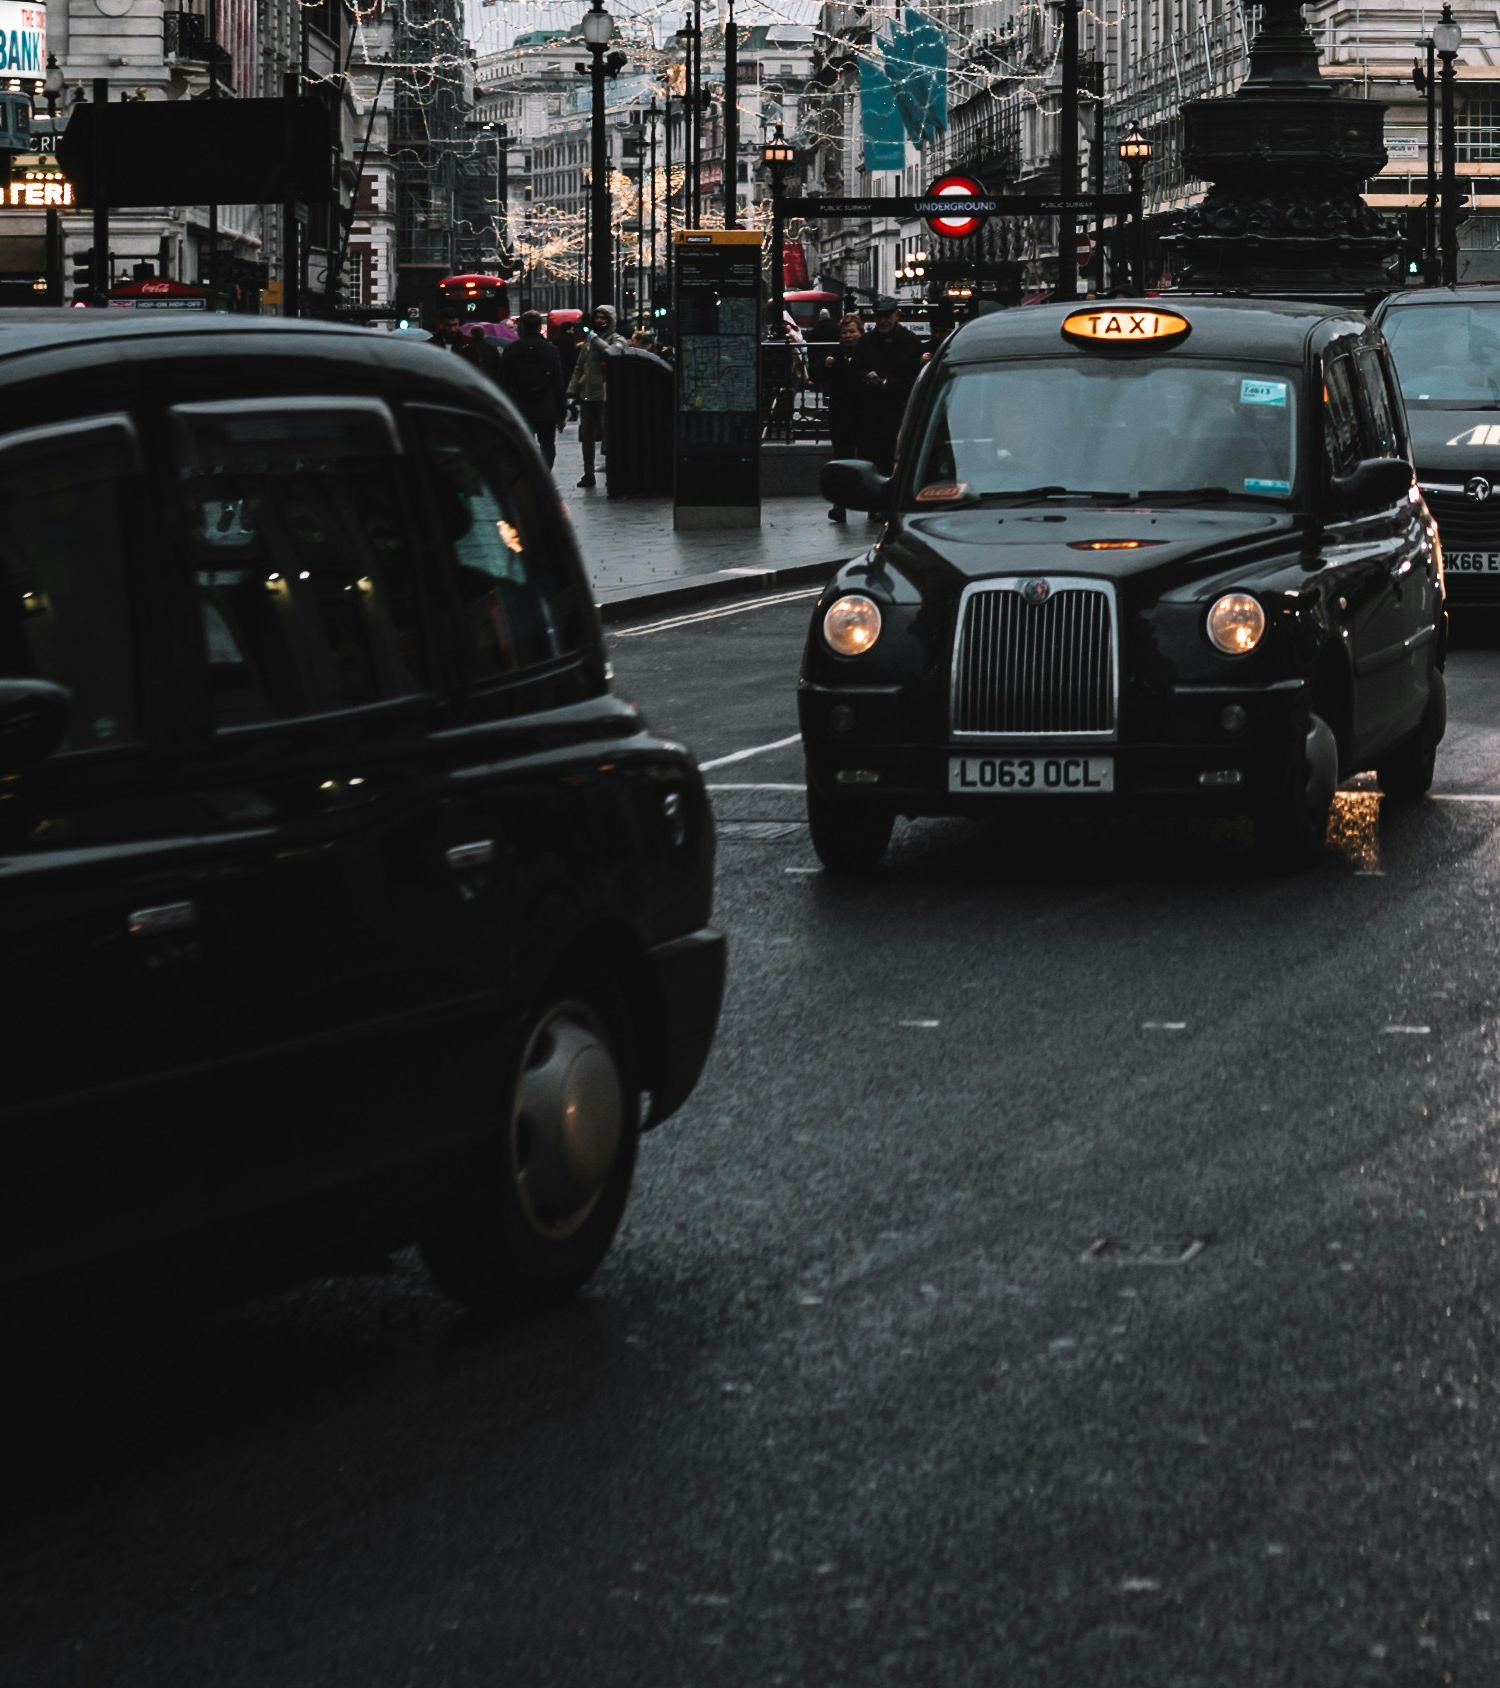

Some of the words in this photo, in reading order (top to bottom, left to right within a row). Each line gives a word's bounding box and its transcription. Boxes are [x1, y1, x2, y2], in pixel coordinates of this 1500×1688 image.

[819, 204, 842, 212] PUBLIC
[914, 201, 997, 212] UNDERGROUND
[1088, 316, 1159, 334] TAXI
[960, 759, 1035, 787] LO63
[1043, 759, 1101, 787] OCL
